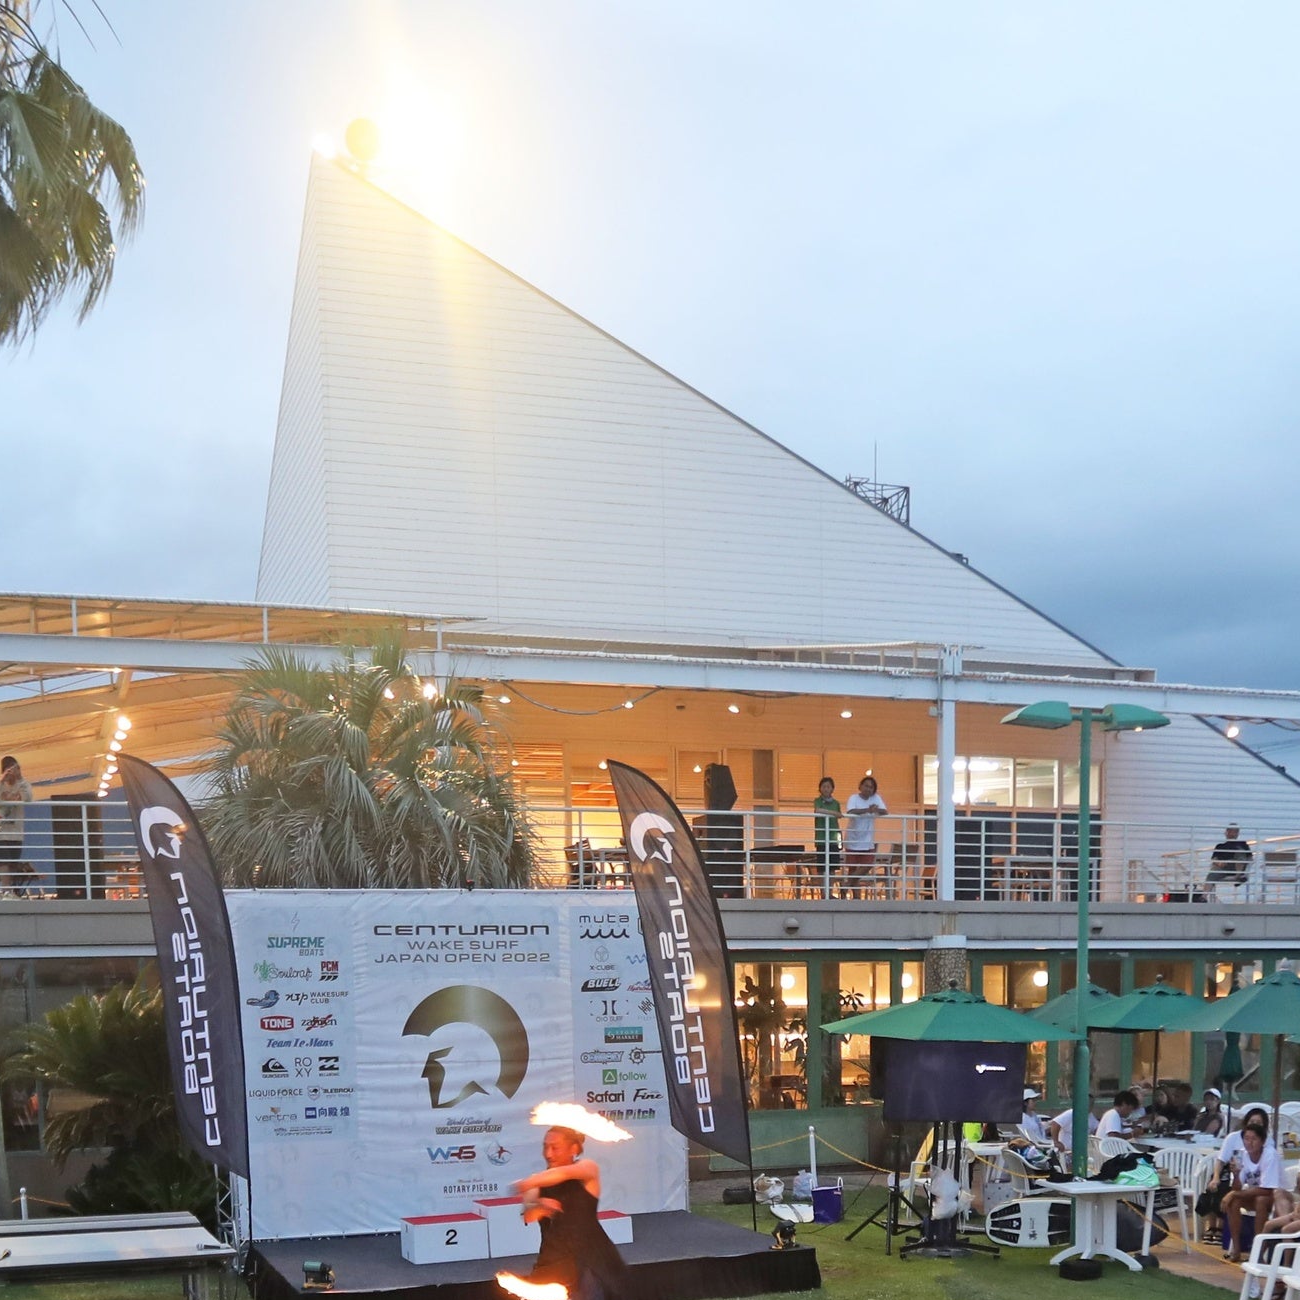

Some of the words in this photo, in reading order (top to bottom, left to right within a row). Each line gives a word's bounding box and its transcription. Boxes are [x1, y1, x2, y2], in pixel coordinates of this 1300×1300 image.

[373, 925, 550, 936] CENTURION
[267, 936, 325, 949] SUPREME
[407, 940, 464, 950] WAKE
[469, 940, 519, 950] SURF
[298, 948, 325, 957] BOATS
[374, 953, 439, 964] JAPAN
[444, 953, 496, 963] OPEN
[502, 952, 550, 963] 2022
[320, 961, 339, 972] PCM
[587, 977, 621, 989] BUELL
[262, 1019, 292, 1029] TONE
[619, 1072, 647, 1081] follow
[249, 1089, 276, 1098] LIQUID
[277, 1088, 303, 1096] FORCE
[586, 1090, 625, 1103] Safari
[633, 1088, 664, 1102] Fine
[625, 1108, 656, 1120] Pitch
[443, 1183, 470, 1194] ROTARY
[445, 1229, 458, 1246] 2
